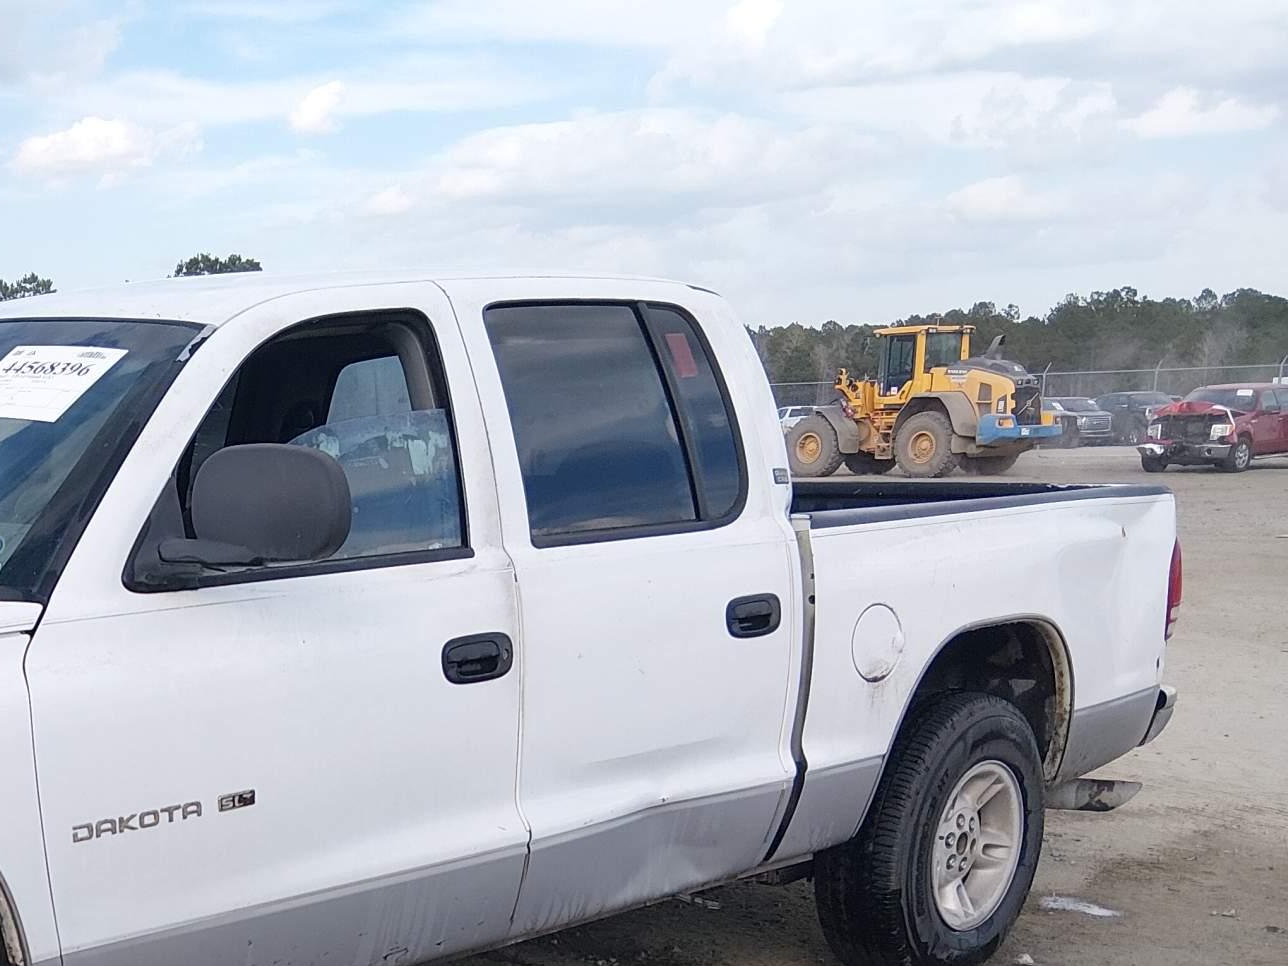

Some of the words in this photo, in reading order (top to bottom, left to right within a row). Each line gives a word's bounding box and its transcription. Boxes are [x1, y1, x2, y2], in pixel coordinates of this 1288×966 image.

[1, 361, 95, 376] 44568396
[72, 800, 202, 843] DAKOTA
[220, 791, 255, 810] SLT
